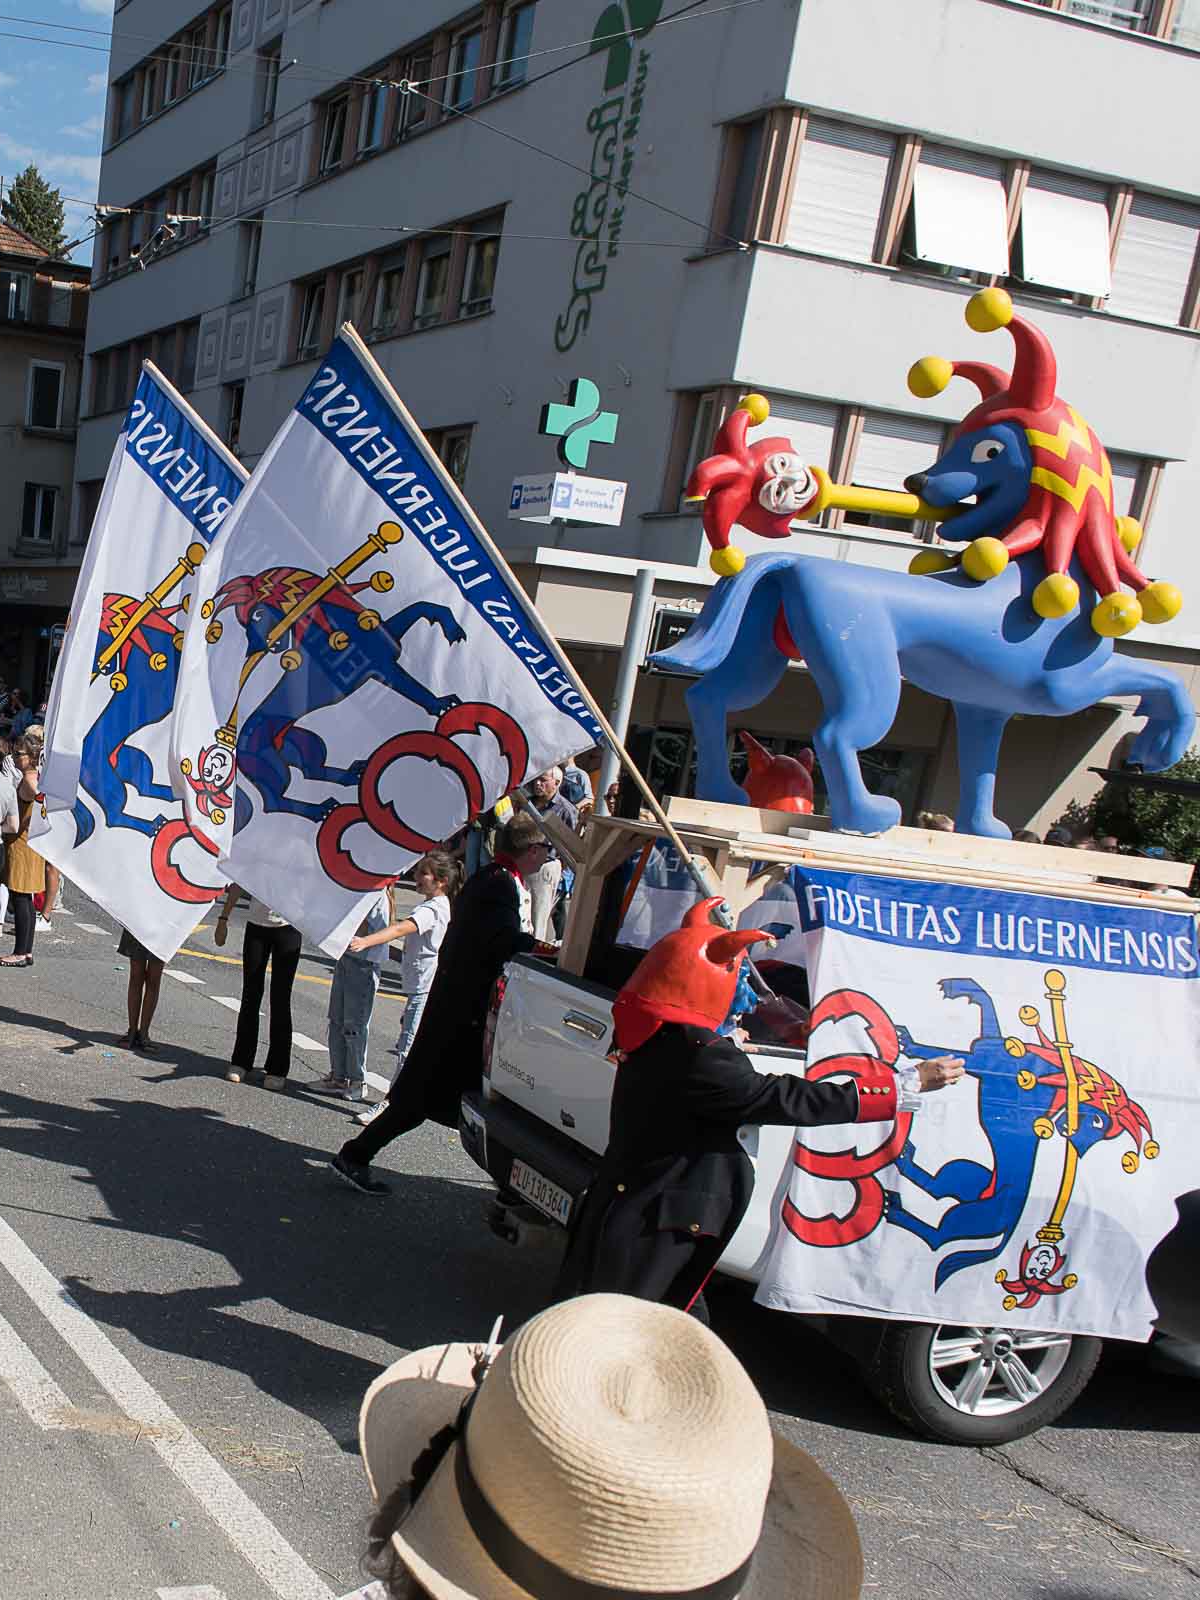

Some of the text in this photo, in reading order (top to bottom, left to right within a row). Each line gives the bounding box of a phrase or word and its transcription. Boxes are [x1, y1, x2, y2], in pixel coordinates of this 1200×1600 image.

[623, 48, 650, 141] Natur
[574, 498, 615, 510] Apotheke
[805, 884, 1198, 973] FIDELITAS LUCERNENSIS
